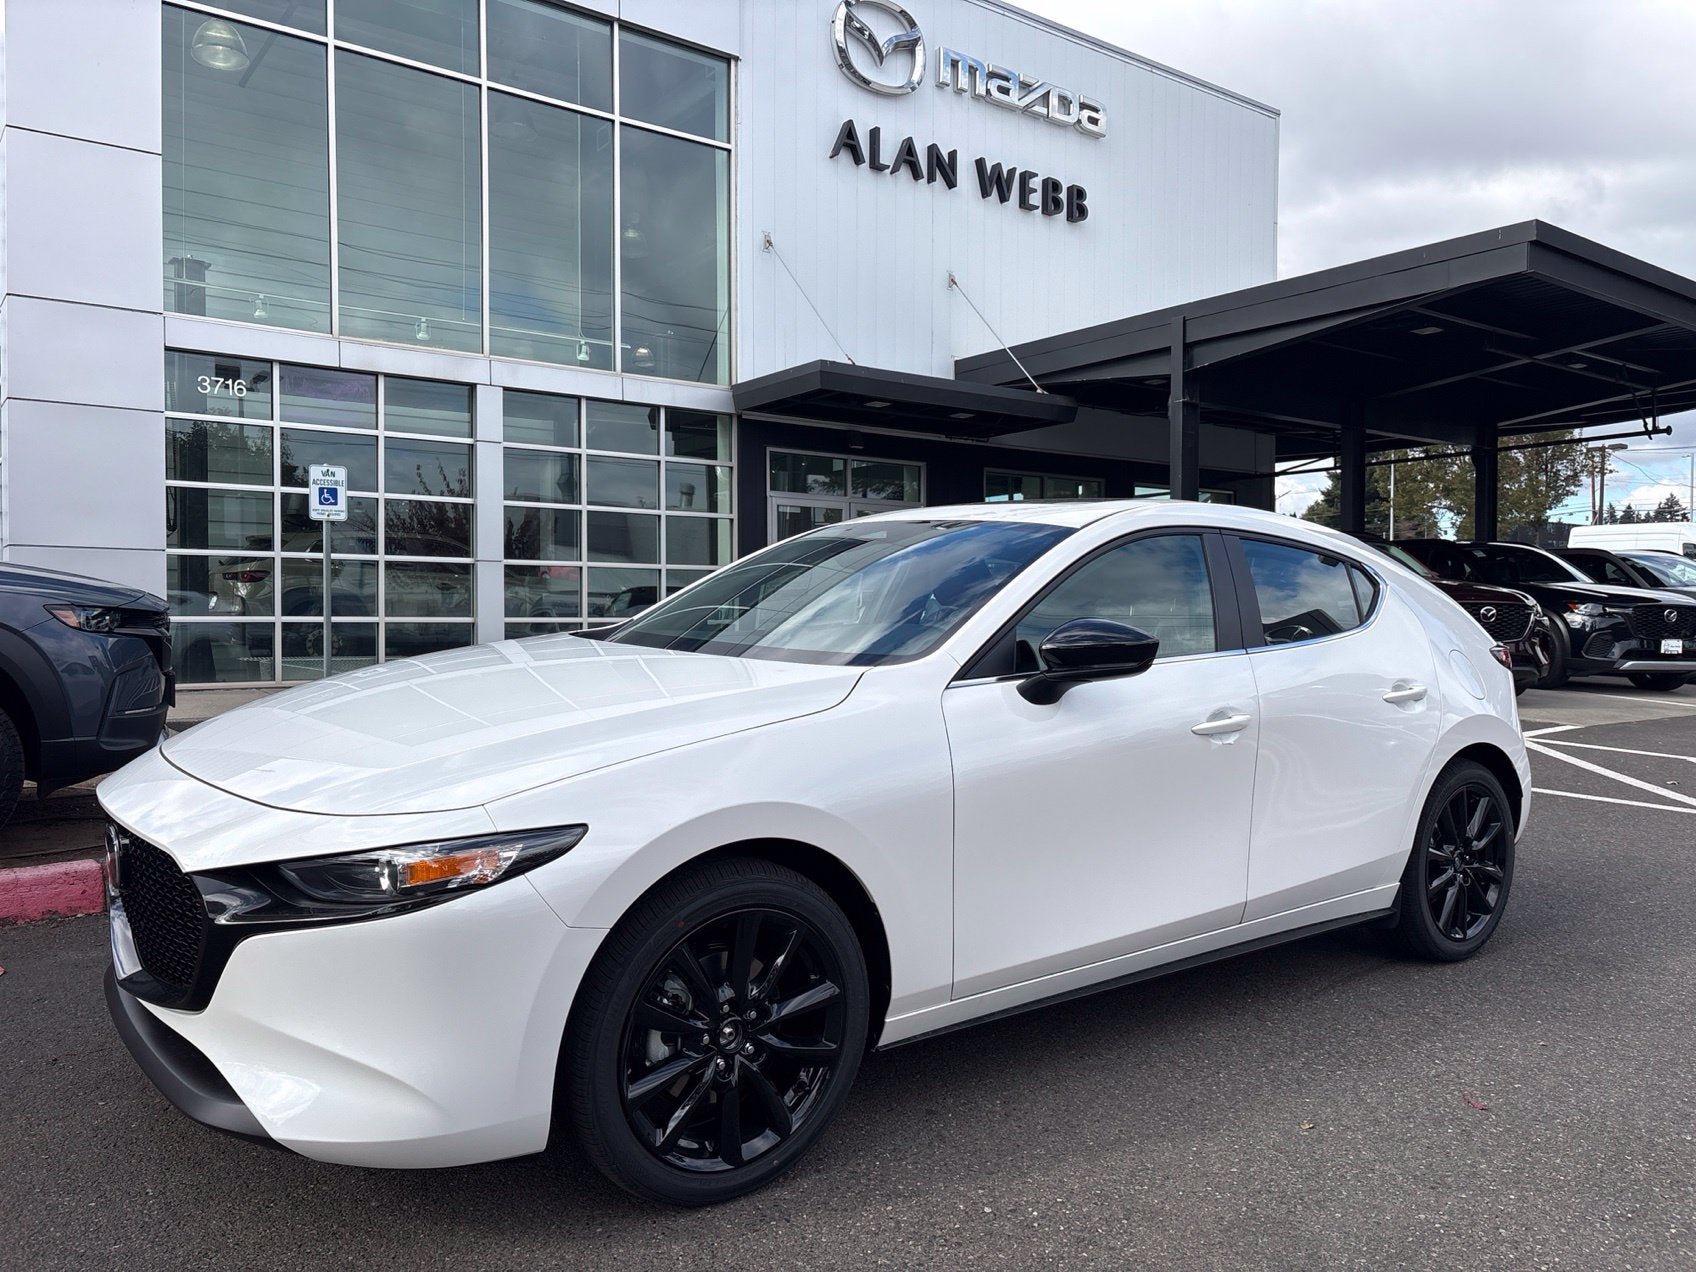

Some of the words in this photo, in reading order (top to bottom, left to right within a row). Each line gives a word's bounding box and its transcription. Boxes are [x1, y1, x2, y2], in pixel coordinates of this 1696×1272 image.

[829, 119, 958, 190] ALAN
[974, 157, 1089, 223] WEBB
[197, 376, 247, 397] 3716
[312, 479, 344, 487] ACCESSIBLE
